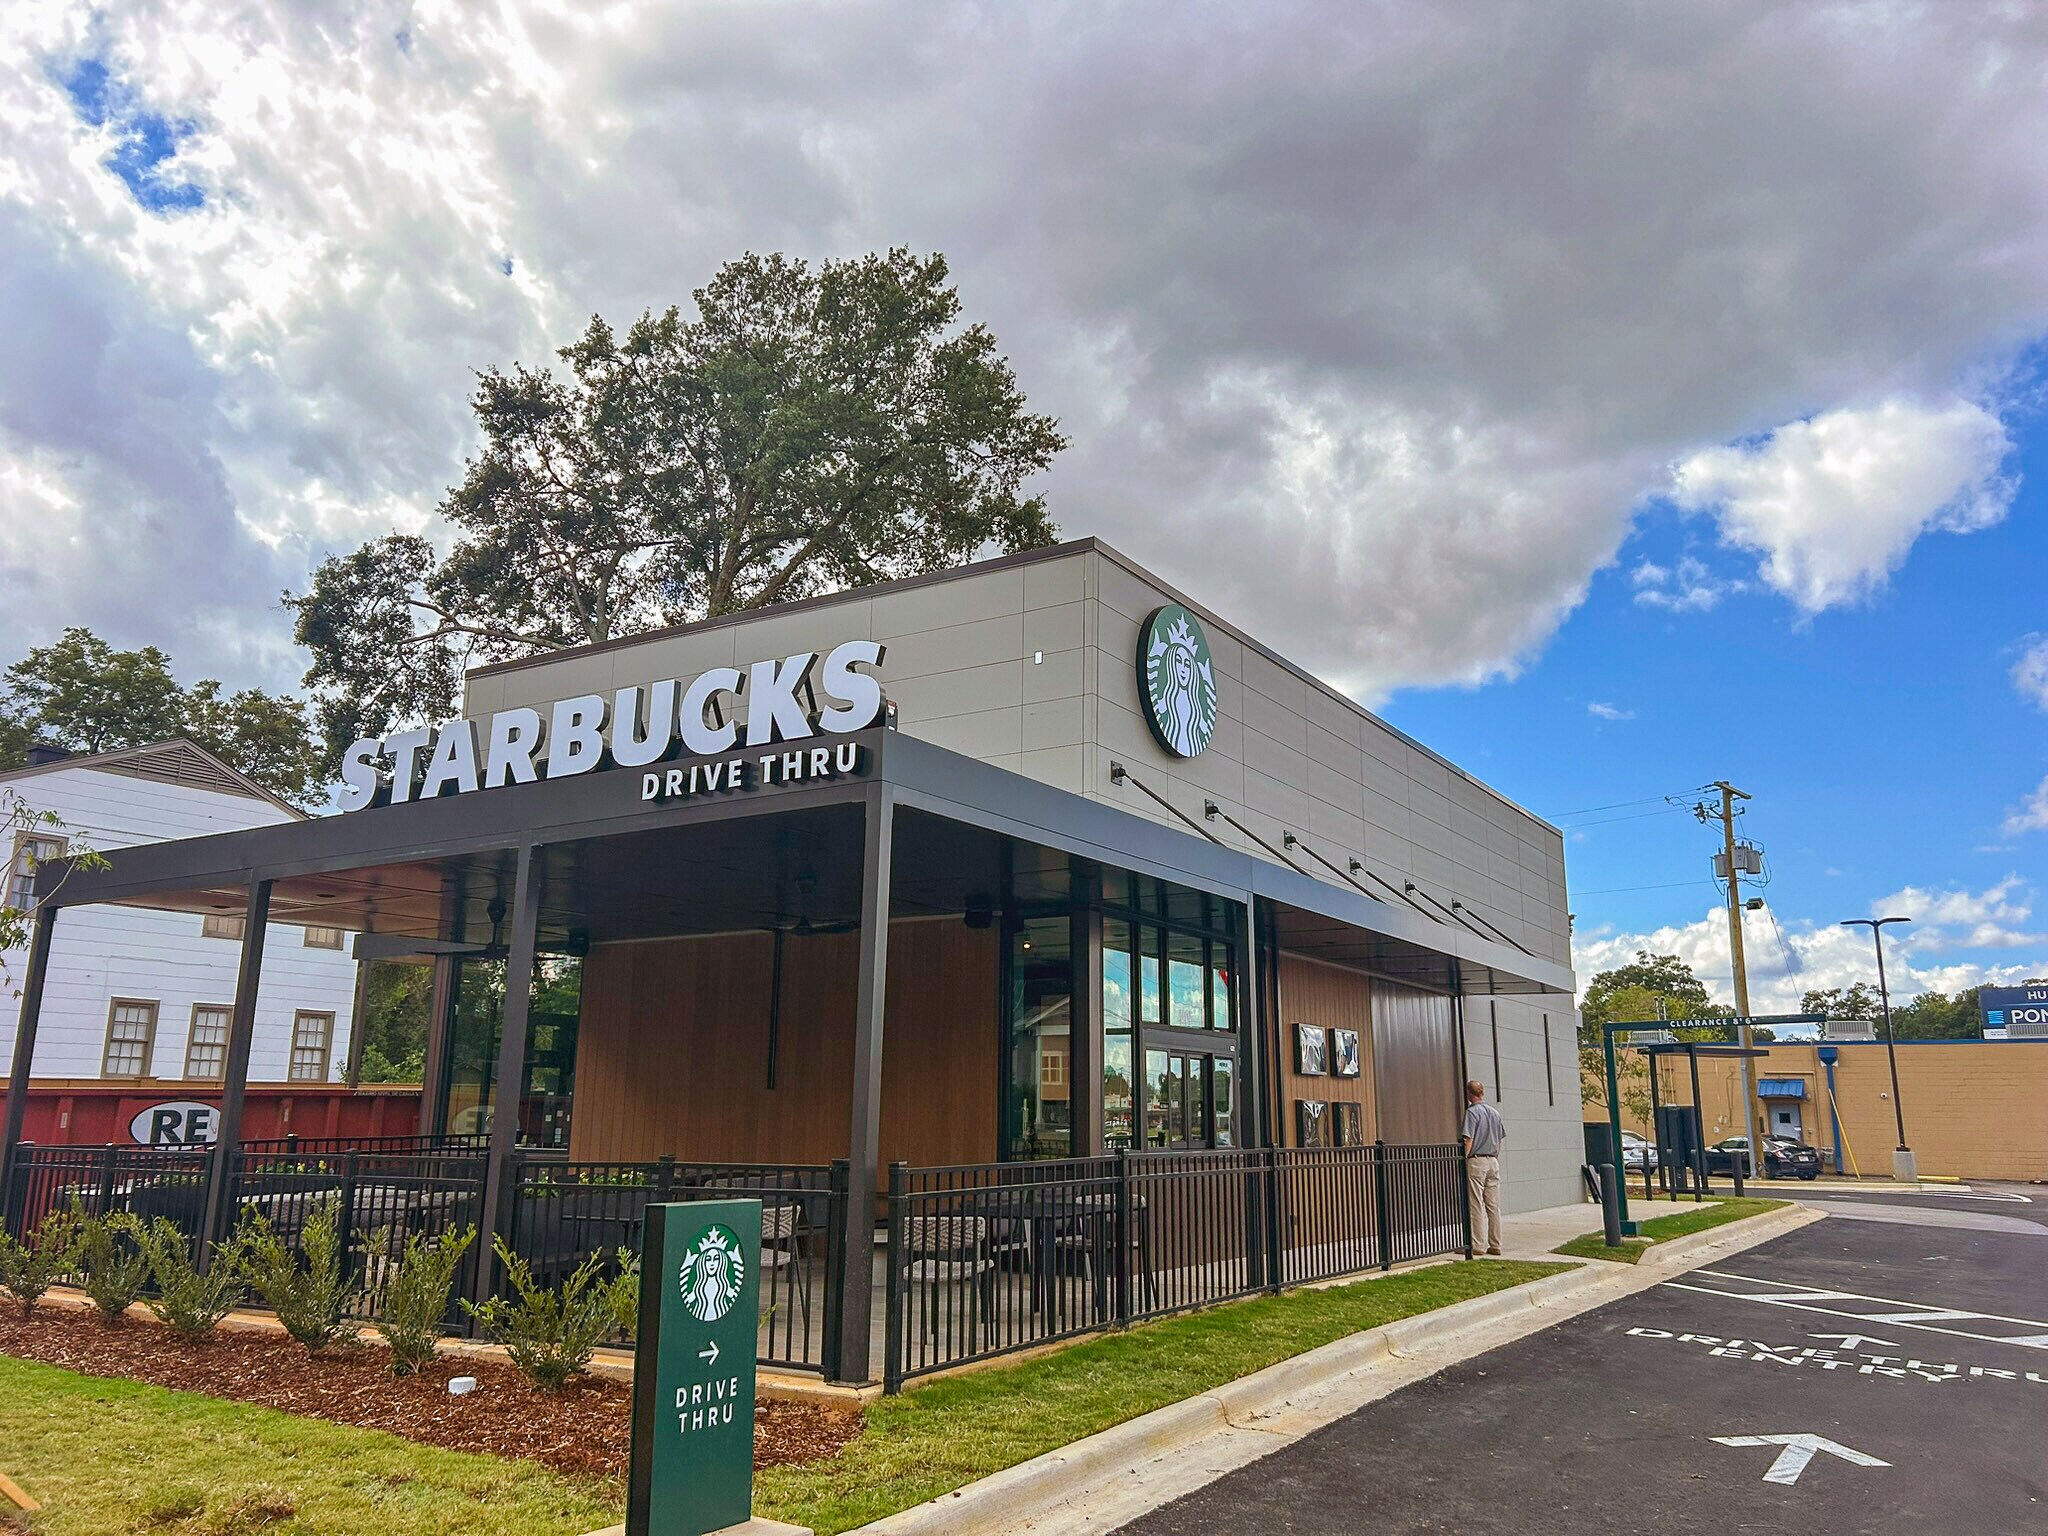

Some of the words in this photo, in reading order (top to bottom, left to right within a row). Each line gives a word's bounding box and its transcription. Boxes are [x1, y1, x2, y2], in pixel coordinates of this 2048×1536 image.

[337, 641, 884, 812] STARBUCKS
[641, 758, 742, 801] DRIVE
[759, 742, 858, 784] THRU
[1669, 1018, 1728, 1028] CLEARANCE
[149, 1109, 211, 1143] RE
[1625, 1327, 1839, 1359] DRIVE
[1708, 1346, 1962, 1383] ENTRY
[675, 1376, 738, 1408] DRIVE
[678, 1403, 733, 1433] THRU
